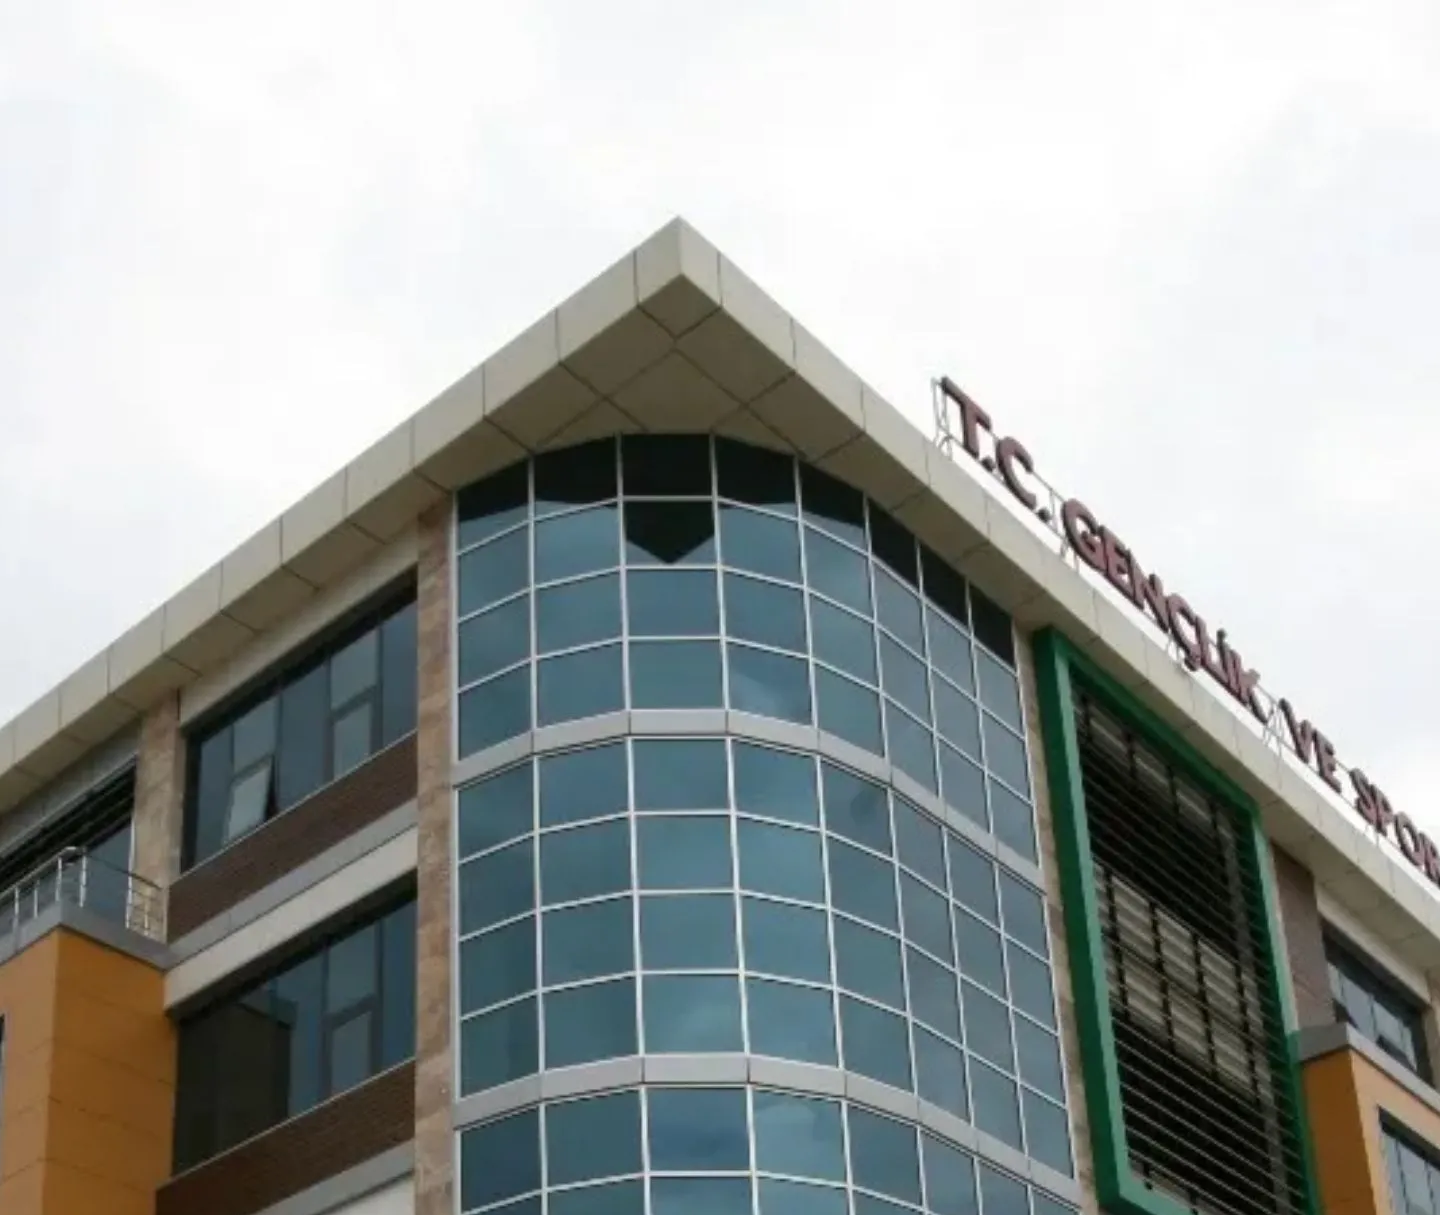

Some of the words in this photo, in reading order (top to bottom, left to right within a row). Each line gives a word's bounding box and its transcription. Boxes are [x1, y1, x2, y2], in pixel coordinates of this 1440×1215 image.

[940, 375, 1051, 523] T.C.
[1061, 498, 1267, 725] GENÇLİK
[1278, 697, 1342, 794] VE
